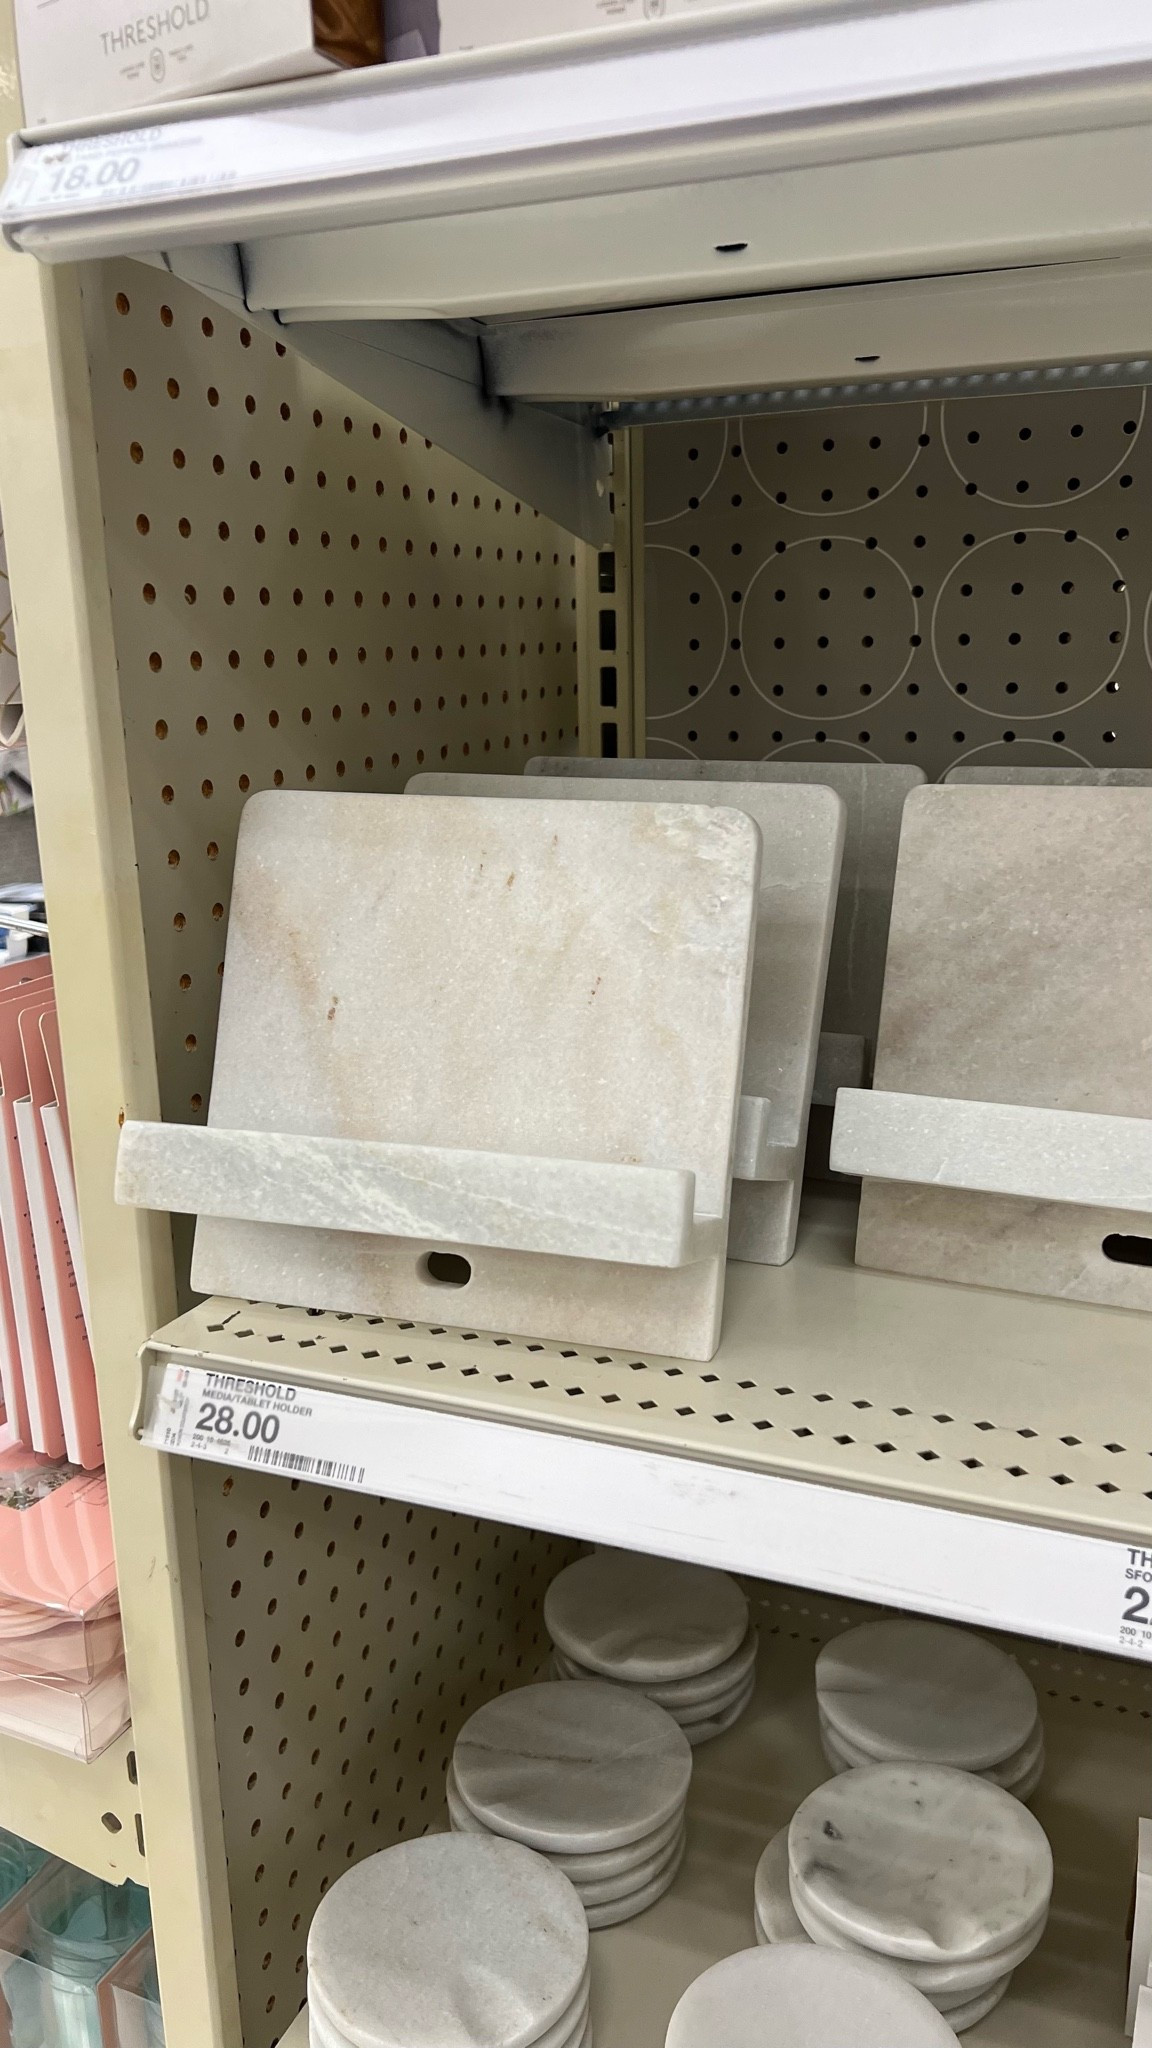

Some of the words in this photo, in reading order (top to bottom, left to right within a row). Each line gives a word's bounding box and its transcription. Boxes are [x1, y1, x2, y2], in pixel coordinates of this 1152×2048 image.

[99, 0, 209, 56] THRESHOLD
[51, 157, 140, 193] 18.00
[206, 1372, 297, 1402] THRESHOLD
[202, 1388, 271, 1410] MEDIA/TABLET
[272, 1401, 313, 1417] HOLDER
[195, 1402, 280, 1444] 28.00
[1127, 1547, 1152, 1568] TH
[1125, 1568, 1152, 1583] SFO
[1119, 1625, 1136, 1637] 200
